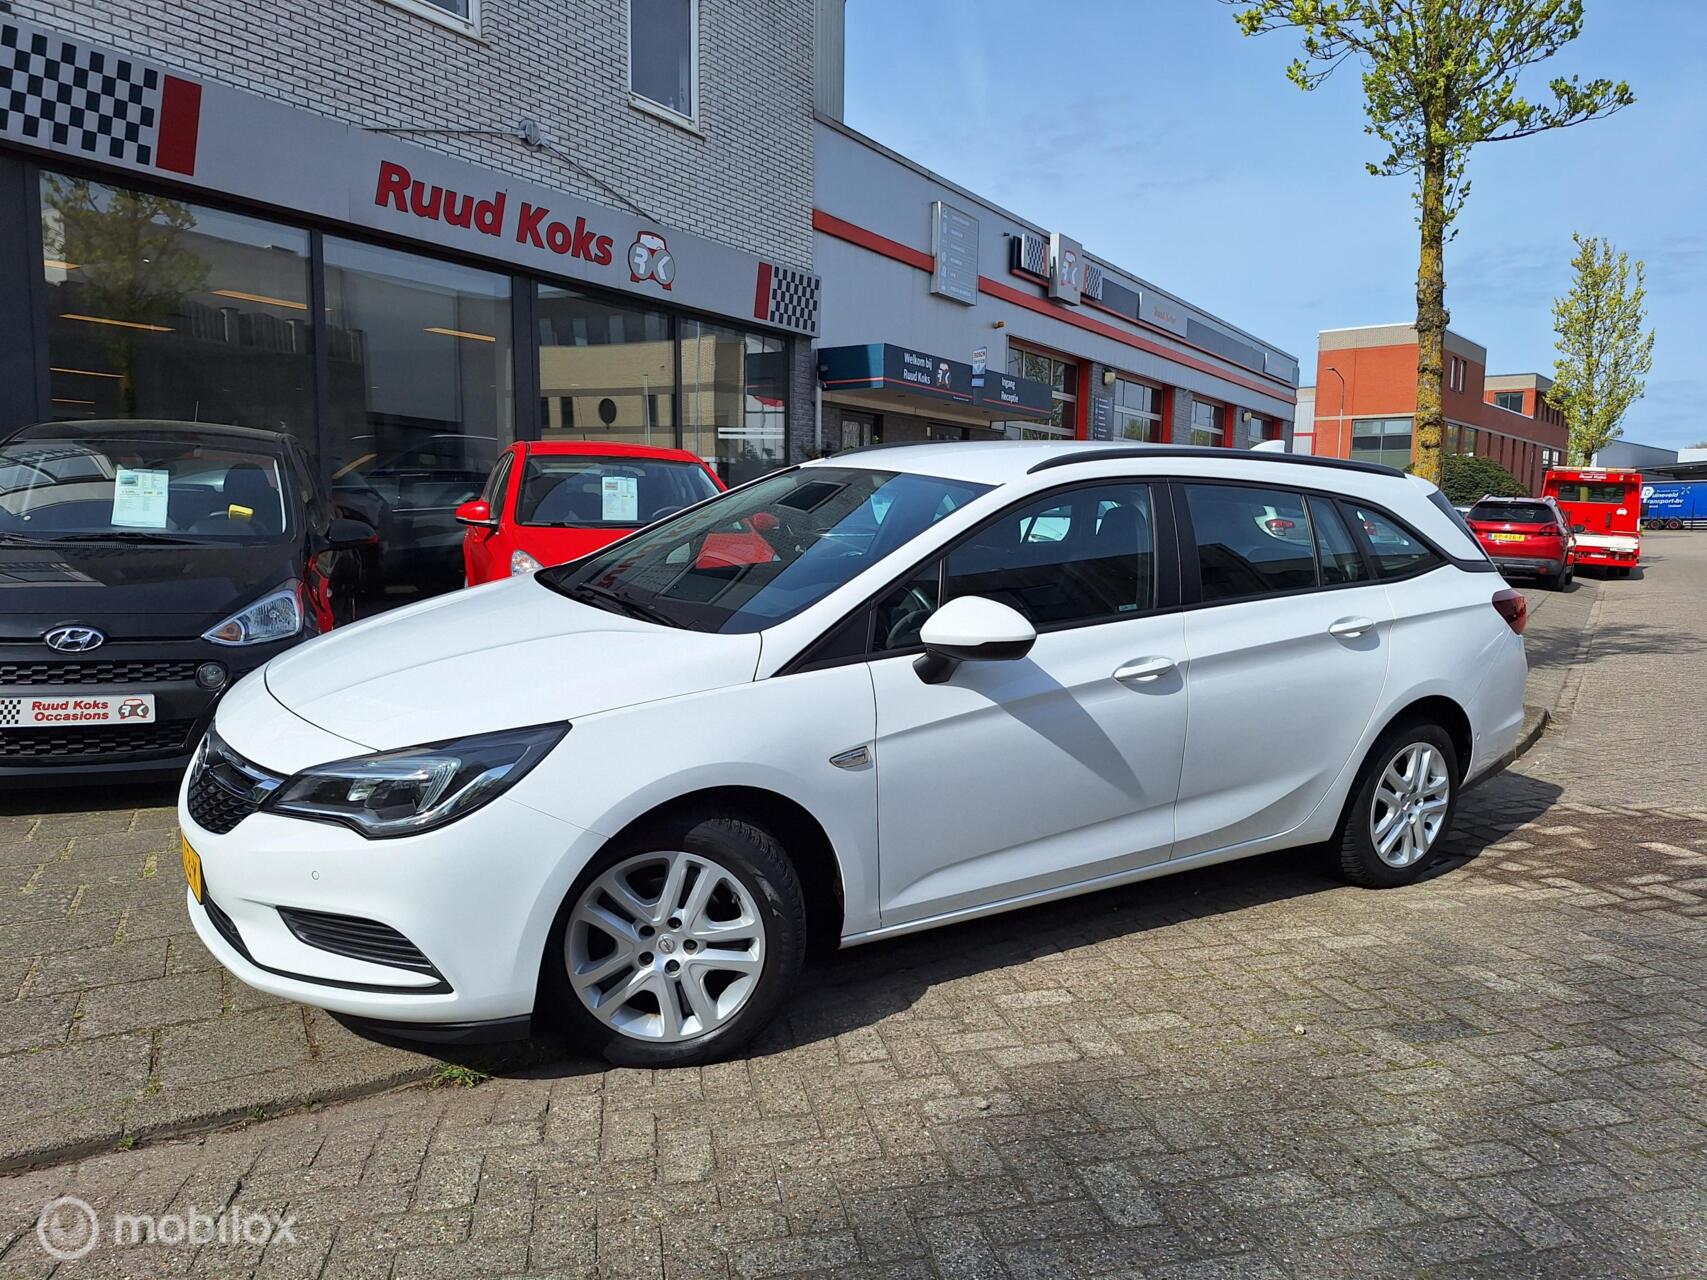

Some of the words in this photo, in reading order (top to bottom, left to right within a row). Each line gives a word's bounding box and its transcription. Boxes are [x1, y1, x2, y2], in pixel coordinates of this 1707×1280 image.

[374, 159, 507, 238] Ruud
[515, 201, 614, 266] Koks
[903, 351, 926, 367] Welkom
[925, 356, 933, 371] bij
[903, 368, 918, 382] Ruud
[917, 371, 931, 385] Koks
[1001, 377, 1016, 391] Ingang
[1000, 391, 1019, 404] Receptie
[31, 701, 69, 711] Ruud
[73, 700, 109, 710] Koks
[34, 712, 109, 722] Occasions
